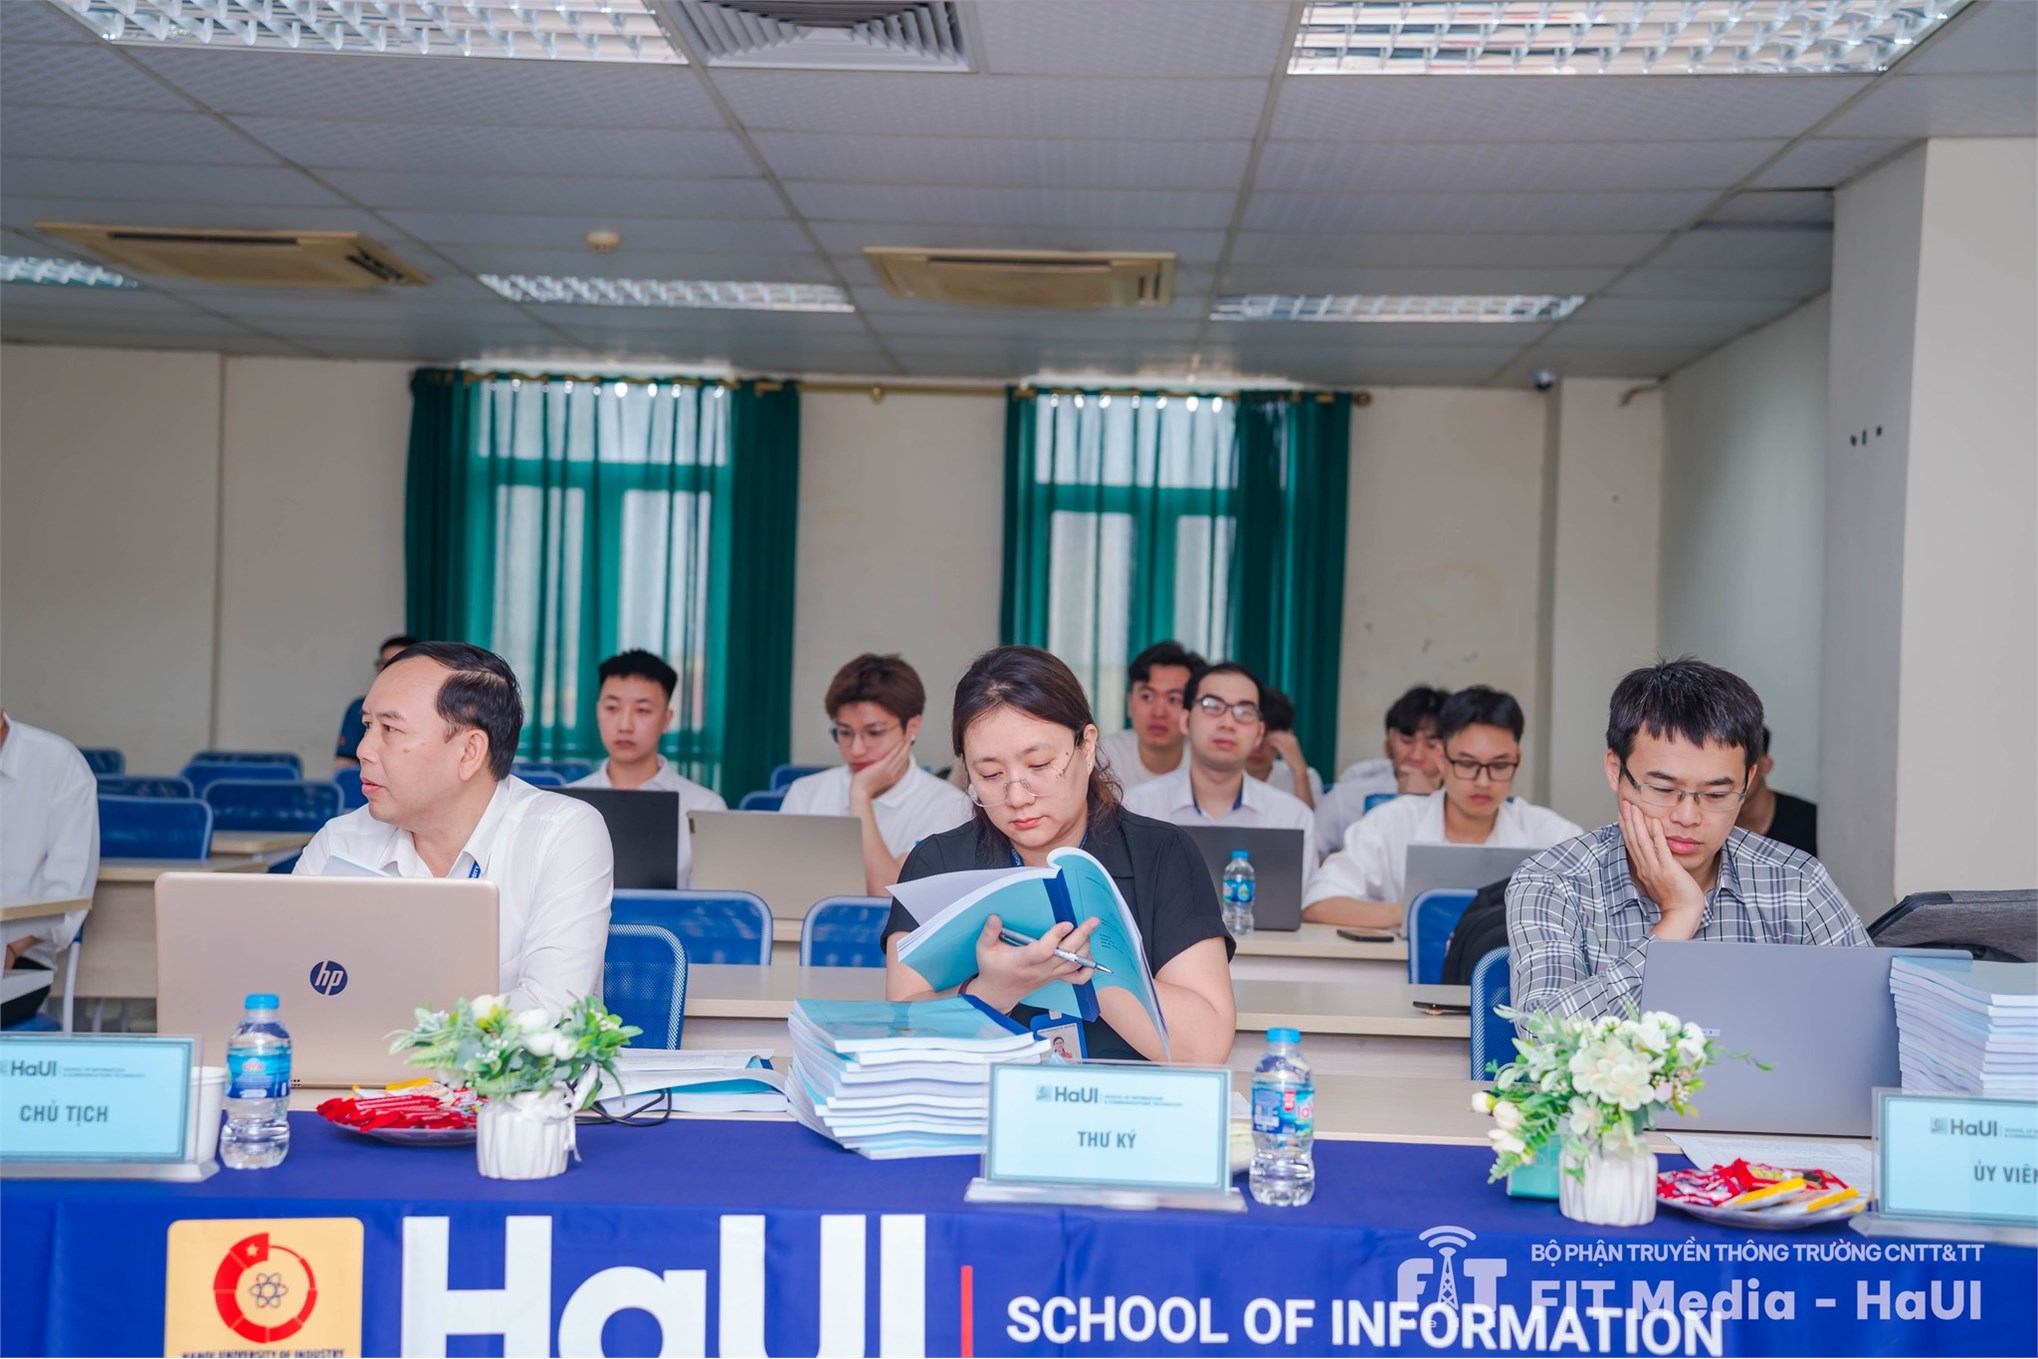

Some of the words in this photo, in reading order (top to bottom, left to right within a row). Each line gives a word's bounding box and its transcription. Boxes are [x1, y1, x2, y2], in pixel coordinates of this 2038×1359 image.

[314, 960, 344, 996] hp
[10, 1060, 57, 1077] HaUI
[1054, 1085, 1098, 1104] HaUI
[19, 1100, 59, 1122] CHỦ
[65, 1105, 109, 1126] TỊCH
[1077, 1130, 1112, 1148] THƯ
[1116, 1128, 1137, 1149] KÝ
[1950, 1118, 1998, 1138] HaUI
[1974, 1160, 1997, 1182] ỦY
[402, 1214, 926, 1358] HaUI
[1006, 1295, 1230, 1344] SCHOOL
[1243, 1297, 1316, 1345] OF
[1331, 1298, 1724, 1357] INFORMATION
